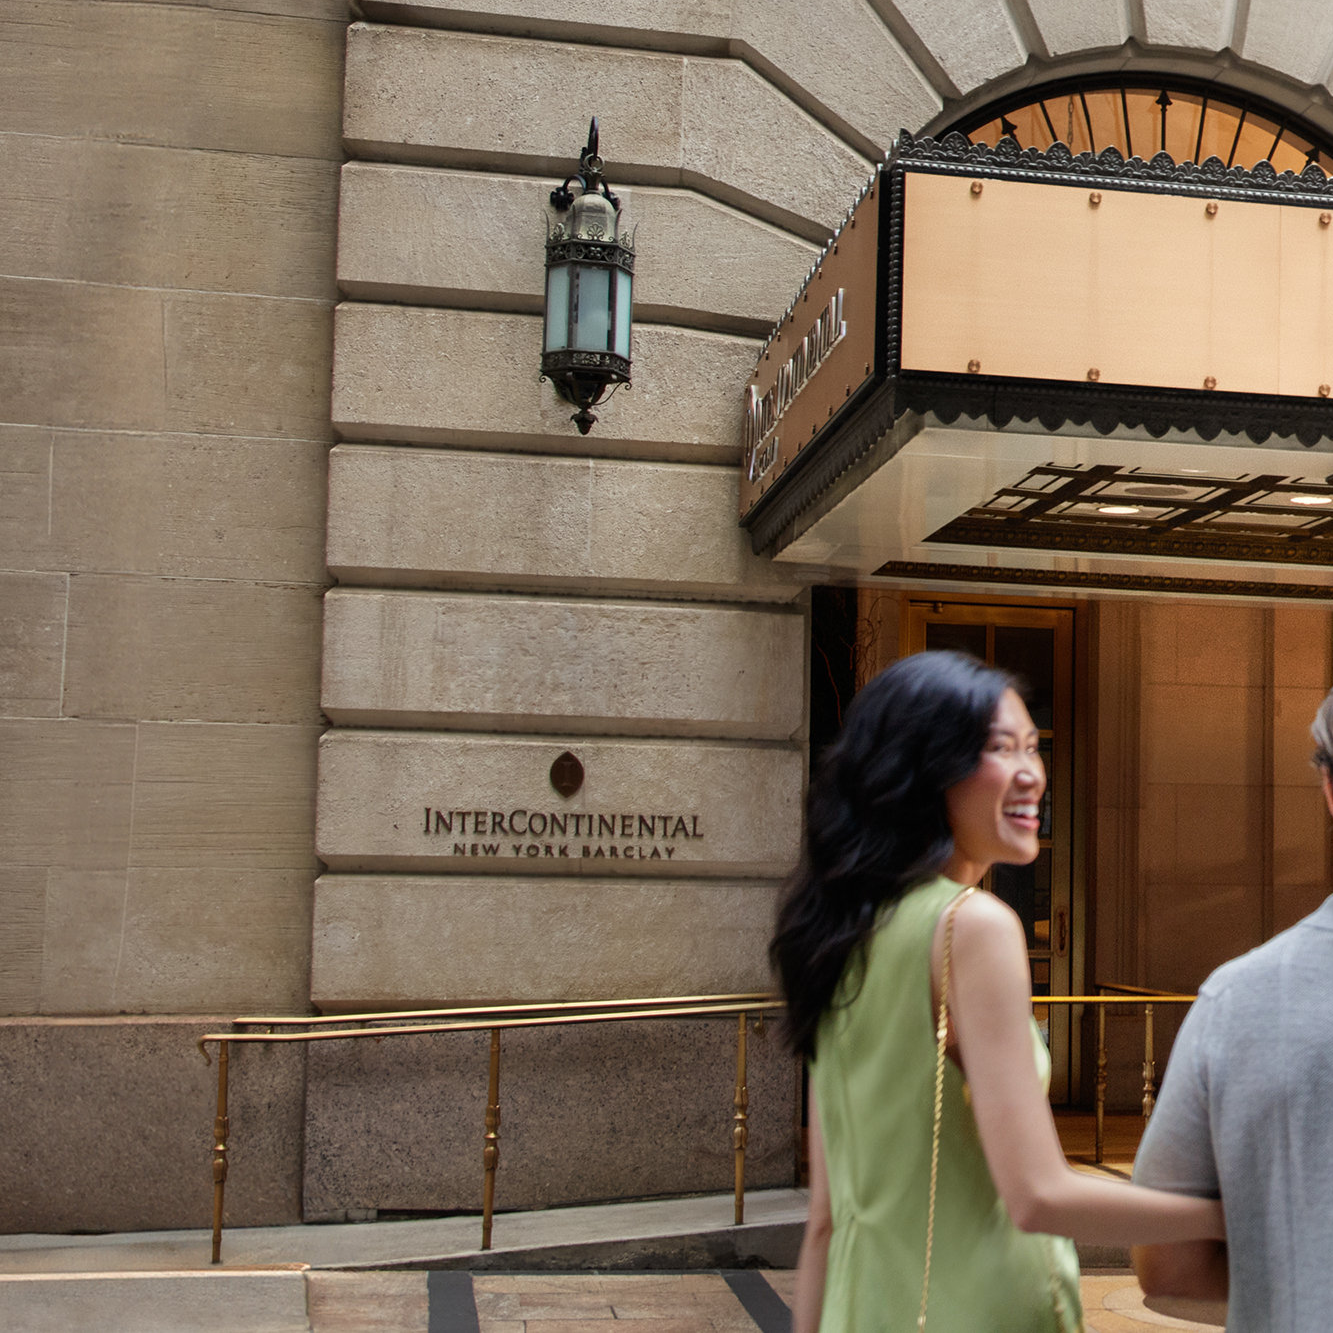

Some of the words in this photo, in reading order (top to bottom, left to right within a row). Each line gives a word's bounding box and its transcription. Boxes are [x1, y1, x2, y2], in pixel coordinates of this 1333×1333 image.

[423, 807, 704, 839] INTERCONTINENTAL
[453, 842, 500, 857] NEW
[512, 843, 569, 858] YORK
[582, 845, 676, 860] BARCLAY
